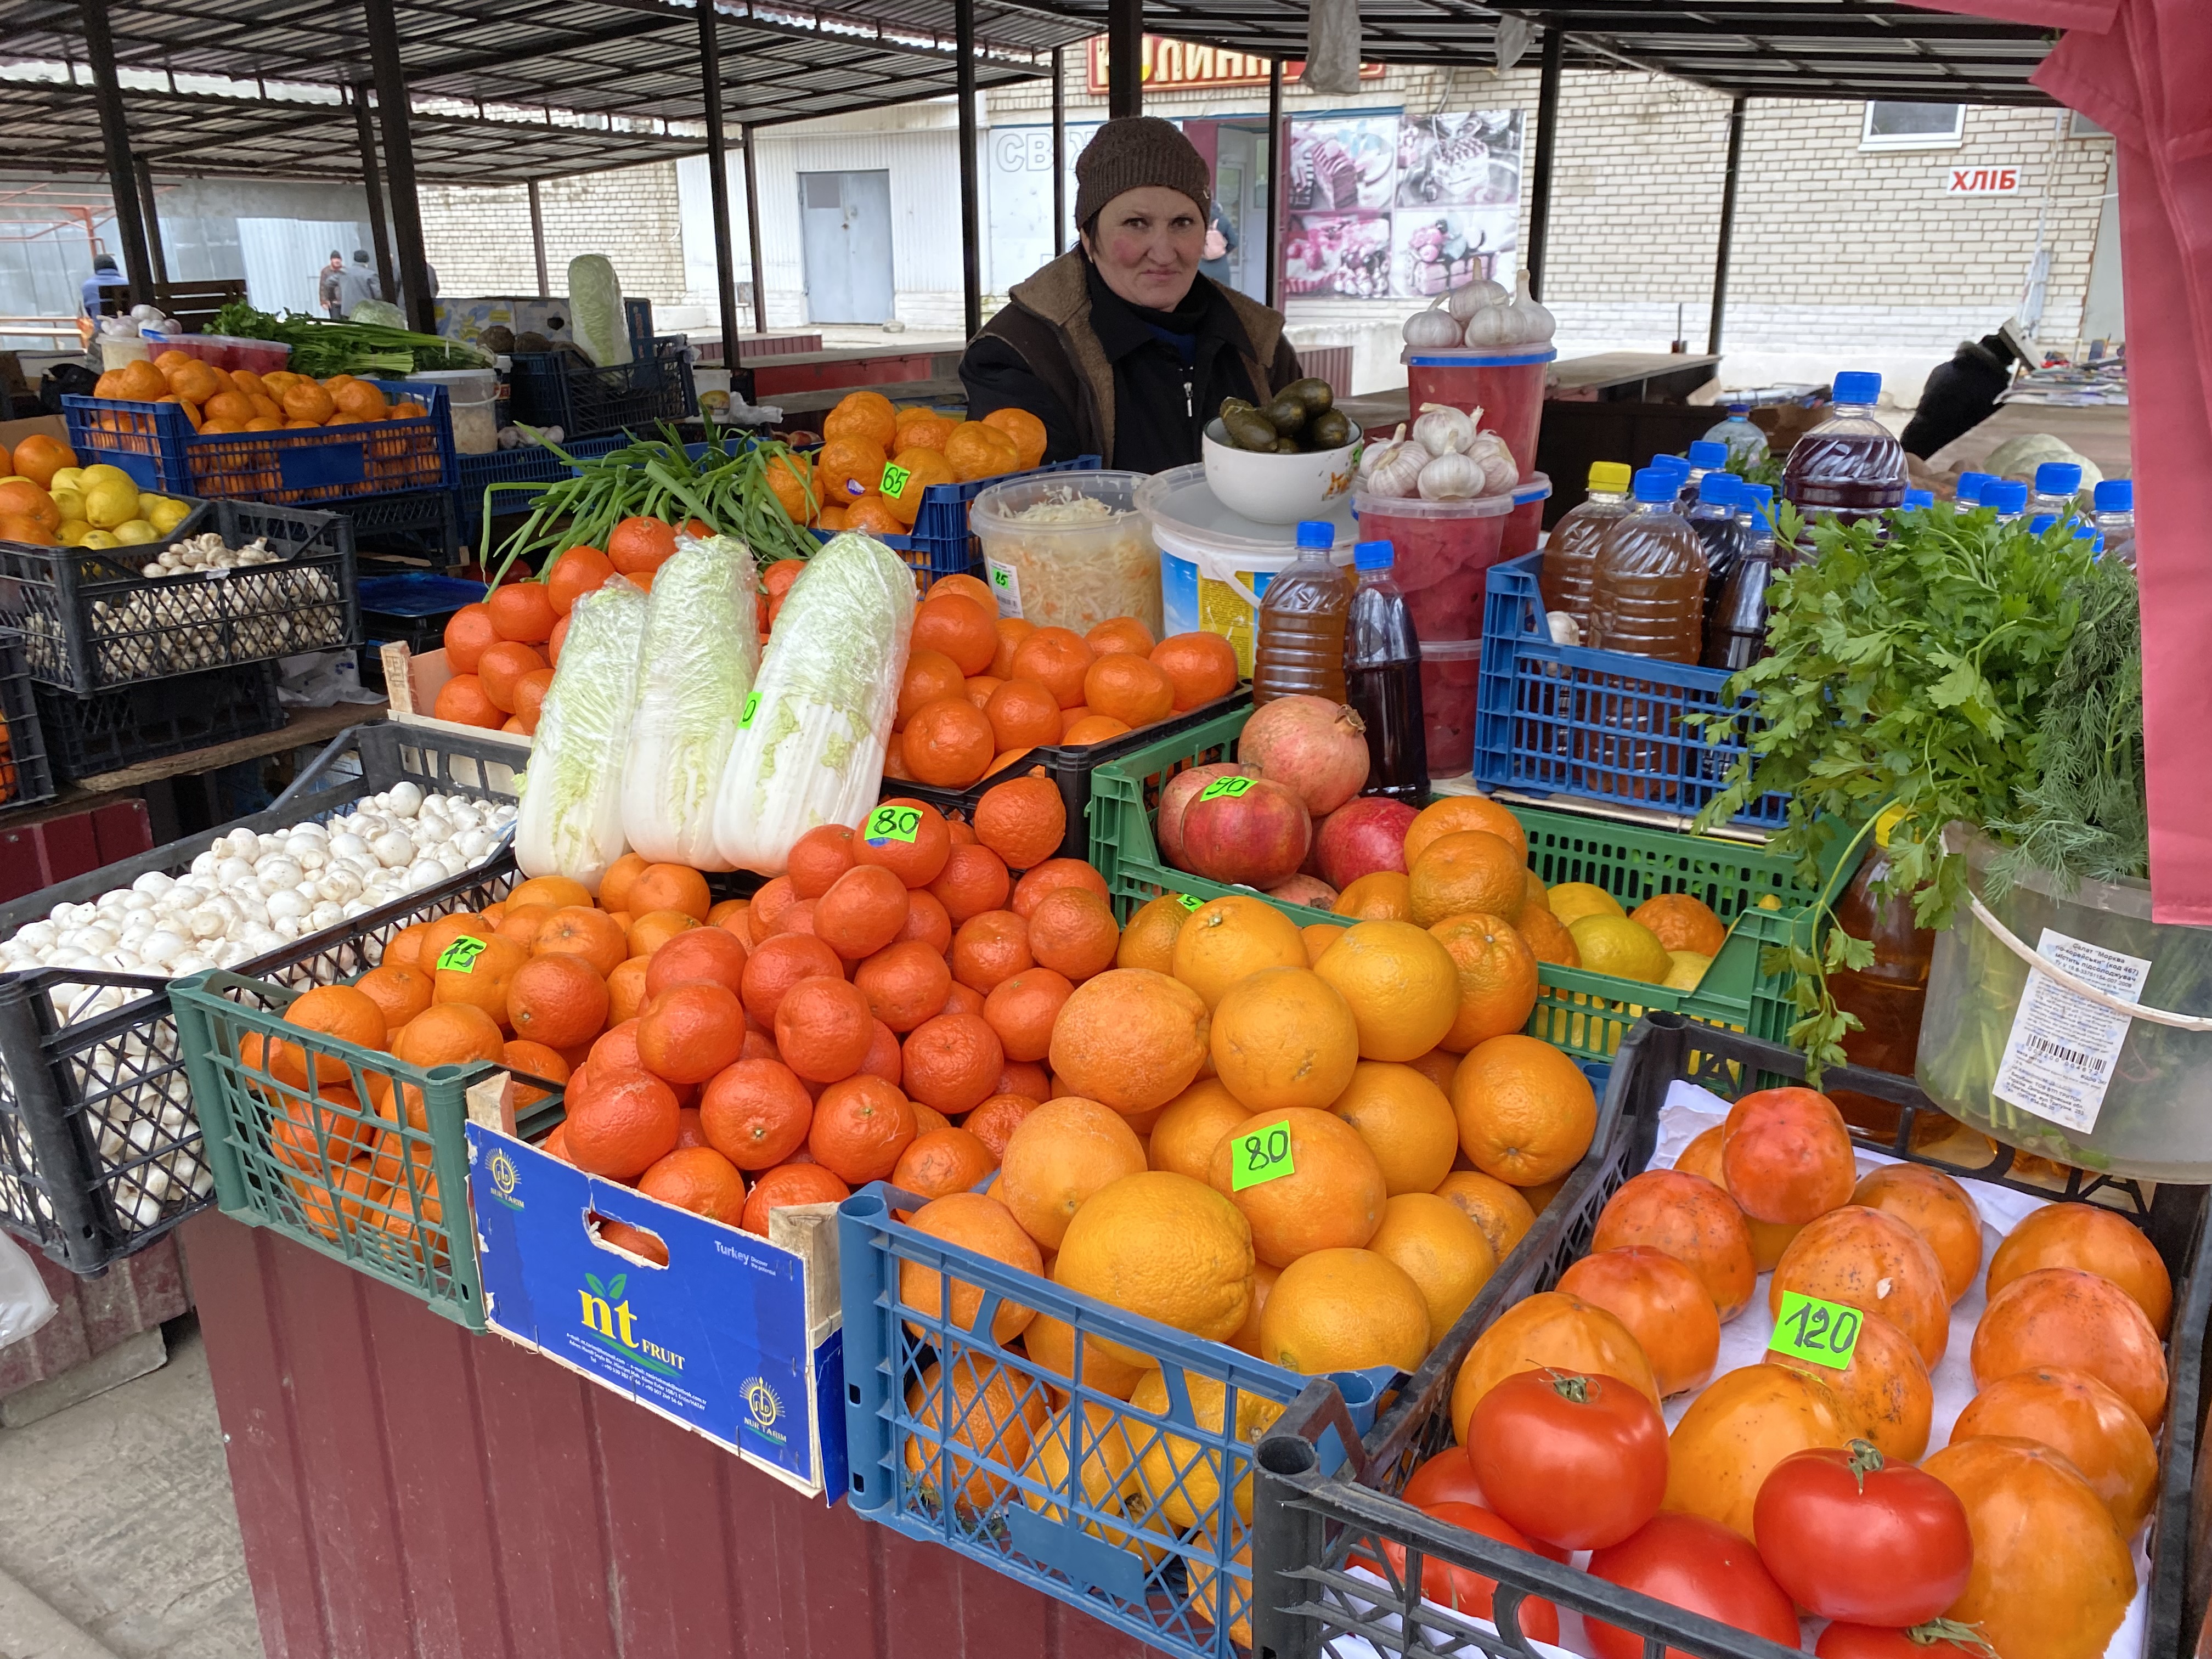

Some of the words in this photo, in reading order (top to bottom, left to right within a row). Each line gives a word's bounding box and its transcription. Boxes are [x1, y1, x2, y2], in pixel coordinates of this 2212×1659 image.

[1950, 170, 2017, 191] ХЛІБ
[883, 467, 909, 494] 65
[1205, 777, 1250, 795] 90
[873, 808, 920, 834] 80
[444, 939, 484, 967] 75
[2073, 943, 2093, 954] Салат
[2055, 953, 2080, 966] містить
[2081, 962, 2136, 982] підсолоджувач
[2106, 961, 2123, 971] (код
[2123, 966, 2139, 976] 467)
[2035, 1082, 2046, 1090] ТОВ
[2059, 1090, 2081, 1103] ТРИТОН
[1245, 1130, 1288, 1171] 80
[490, 1187, 503, 1199] NUR
[504, 1193, 525, 1209] TARIM
[714, 1239, 750, 1266] Turkey
[751, 1256, 768, 1267] Discover
[758, 1266, 776, 1277] potential
[578, 1289, 640, 1348] nt
[641, 1338, 685, 1370] FRUIT
[1784, 1302, 1858, 1354] 120
[744, 1416, 760, 1430] NUR
[761, 1425, 787, 1443] TARIM
